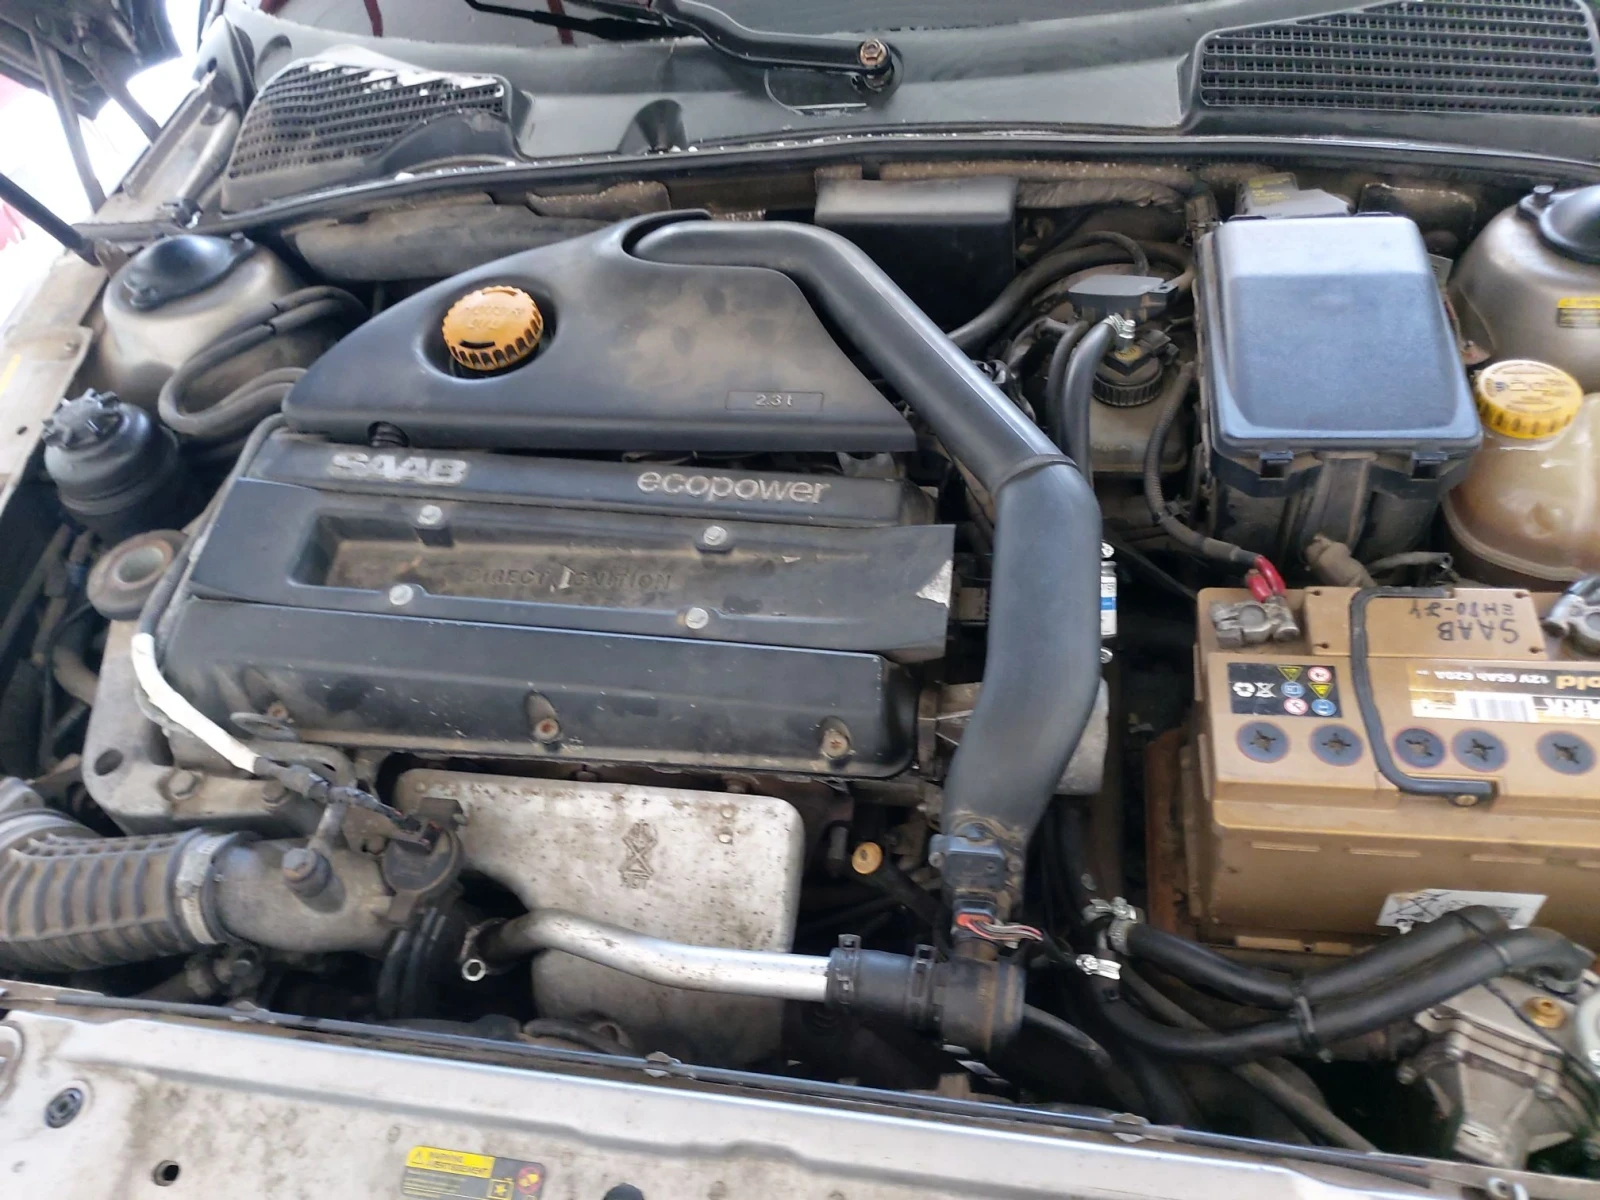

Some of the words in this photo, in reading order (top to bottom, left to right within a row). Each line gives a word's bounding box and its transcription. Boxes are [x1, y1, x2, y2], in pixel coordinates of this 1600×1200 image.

[327, 452, 468, 486] SAAB
[636, 471, 832, 504] ecopower
[464, 566, 551, 587] DIRECT
[558, 566, 672, 591] IGNITION
[1436, 618, 1519, 644] SAAB
[1519, 673, 1551, 684] 12V
